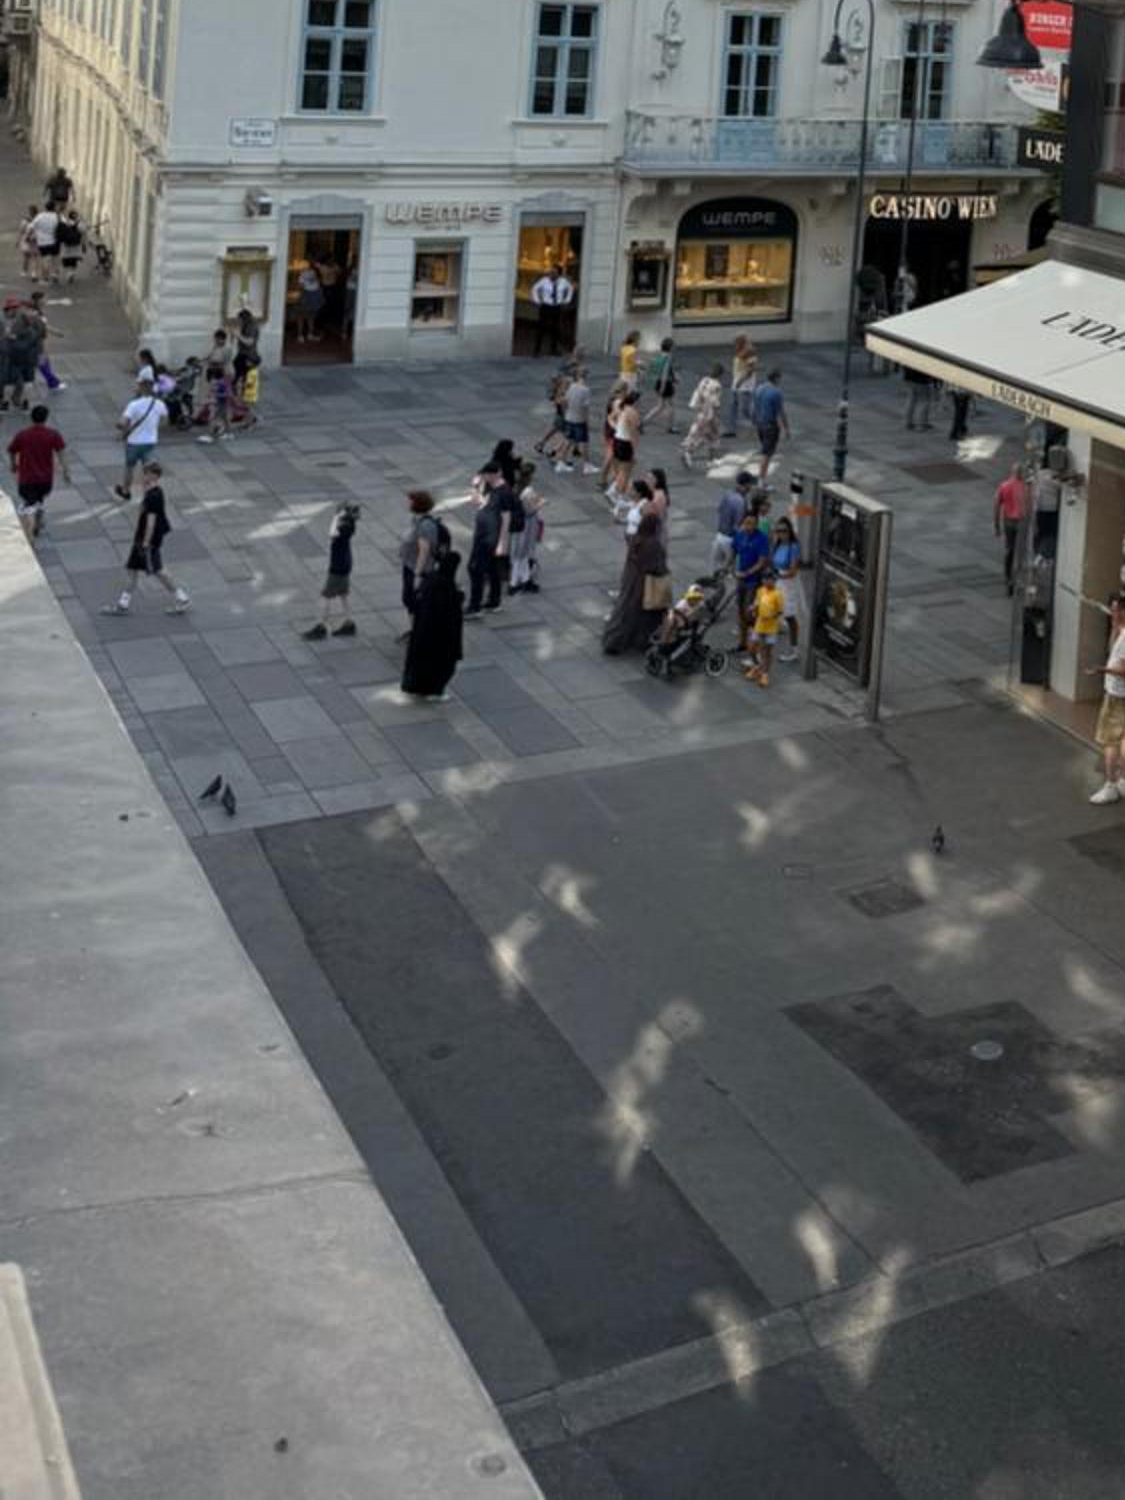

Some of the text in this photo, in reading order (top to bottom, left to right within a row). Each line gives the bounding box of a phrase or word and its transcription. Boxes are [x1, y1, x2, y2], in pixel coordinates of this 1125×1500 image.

[385, 202, 503, 225] WEMPE
[703, 211, 776, 226] WEMPE
[869, 194, 998, 220] CASINO WIEN
